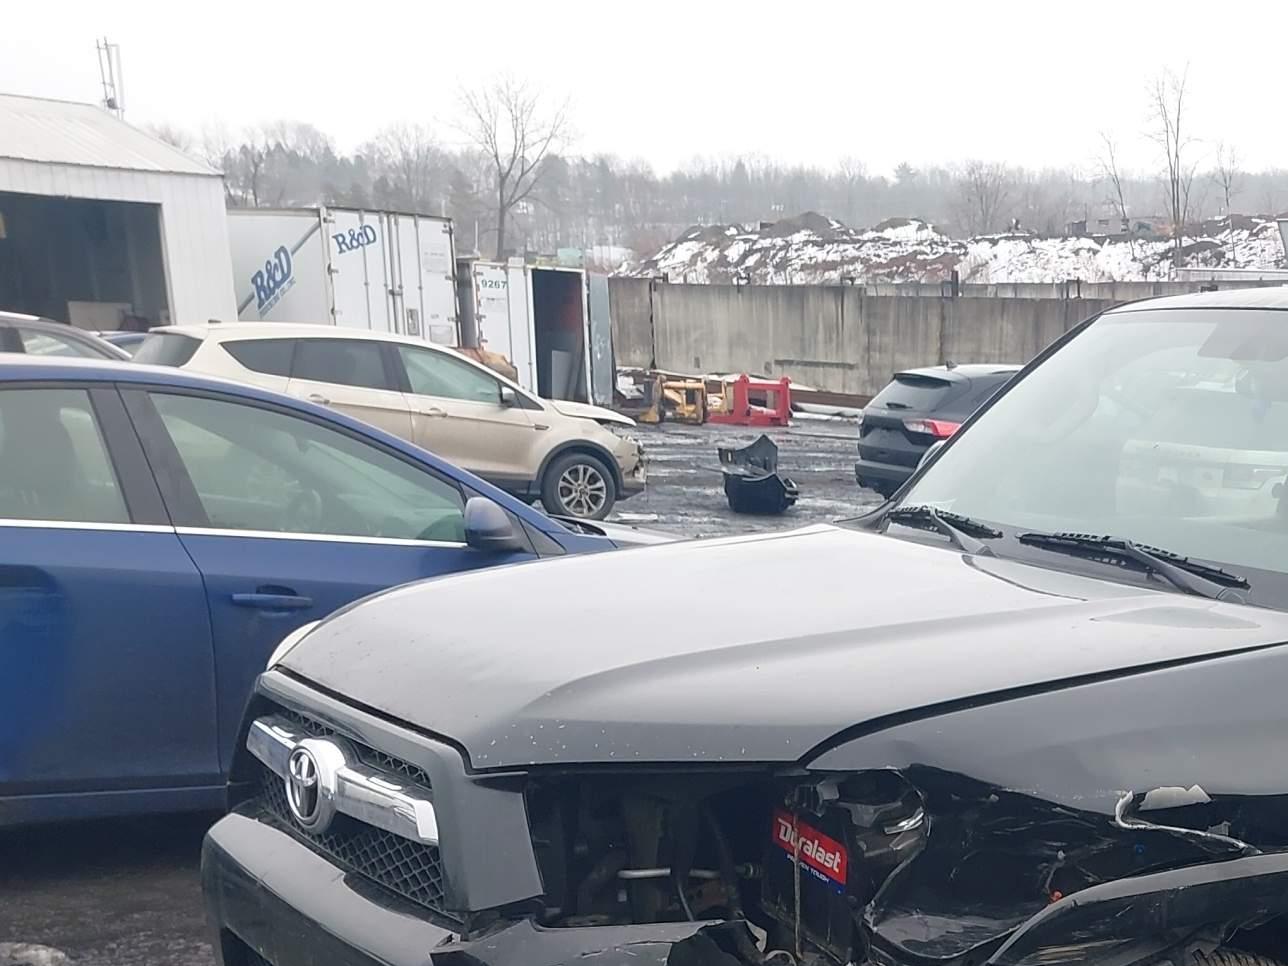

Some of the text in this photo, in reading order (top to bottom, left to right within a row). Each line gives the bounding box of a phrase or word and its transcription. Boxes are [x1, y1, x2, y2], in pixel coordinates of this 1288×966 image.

[332, 225, 377, 254] R&D
[251, 246, 292, 310] R&D
[481, 279, 507, 289] 9267
[777, 817, 842, 874] Duralast
